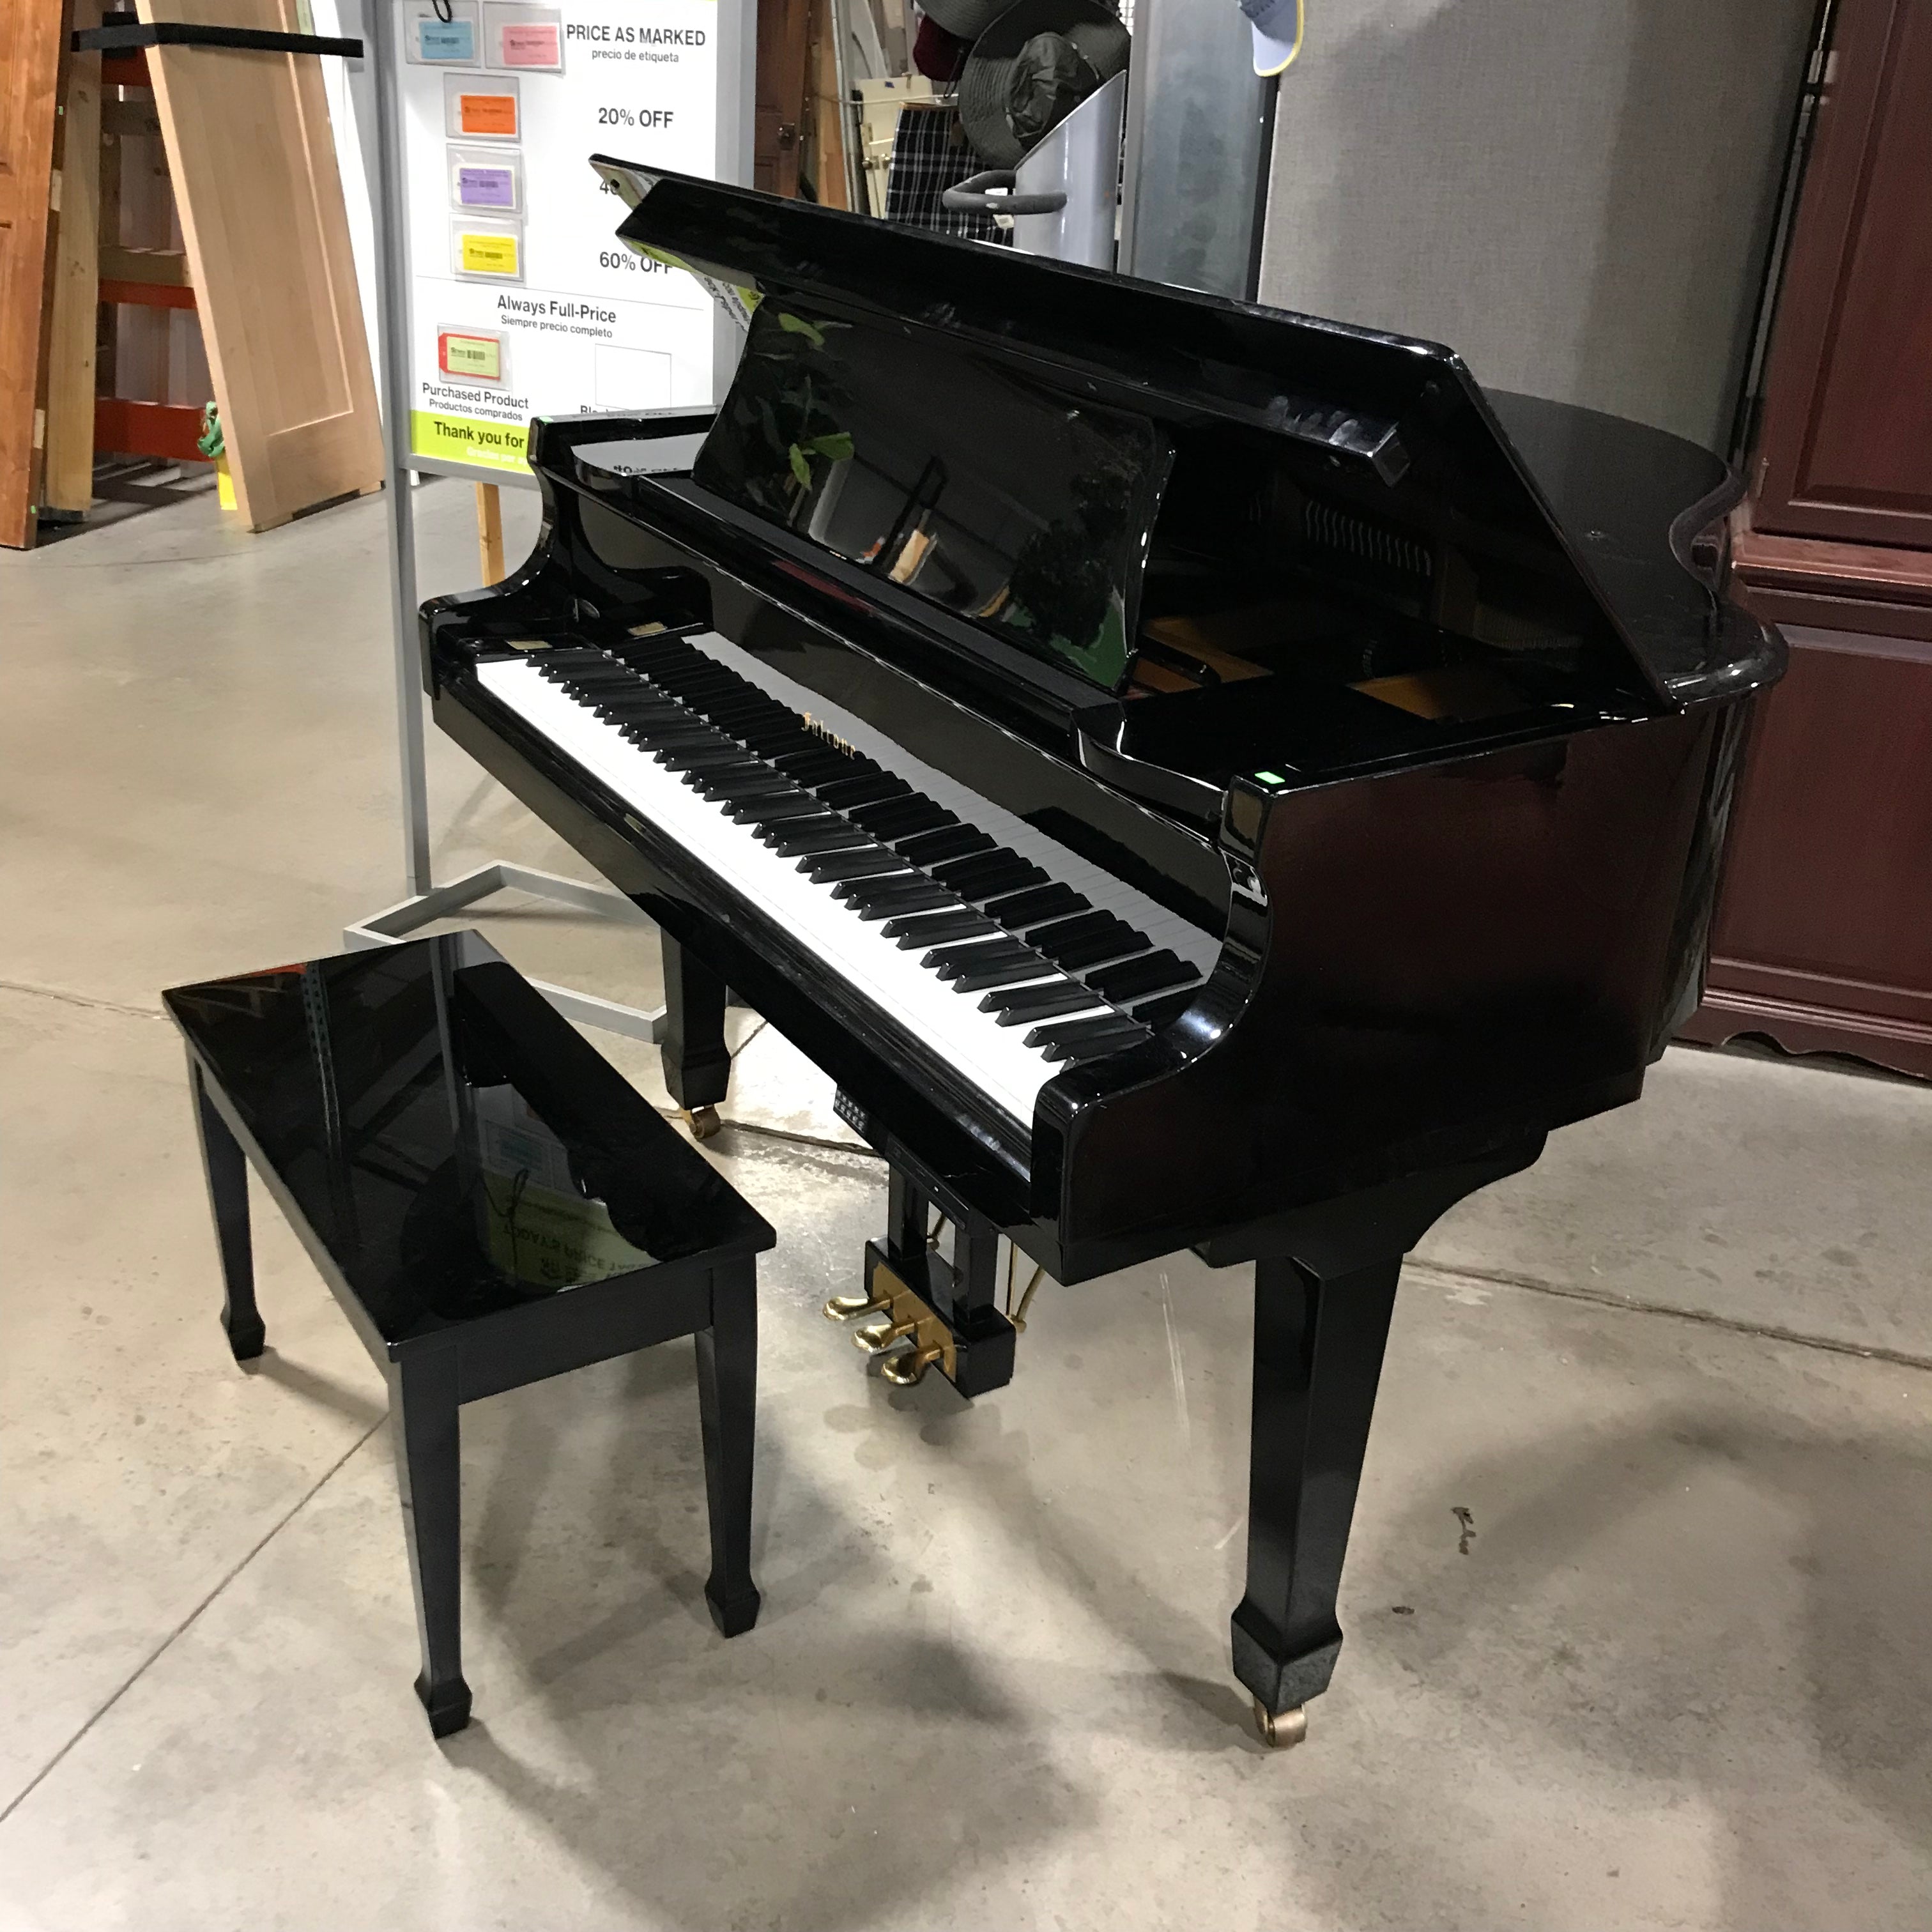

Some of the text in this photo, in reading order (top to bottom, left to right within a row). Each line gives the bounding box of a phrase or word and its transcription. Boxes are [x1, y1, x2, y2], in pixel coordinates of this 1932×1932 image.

[567, 24, 705, 45] PRICE AS MARKED
[592, 48, 679, 64] precio de etiqueta
[599, 108, 673, 128] 20% OFF
[599, 251, 636, 271] 60%
[498, 295, 617, 323] Always Full-Price
[502, 316, 613, 339] Siempre precio completo
[423, 383, 528, 411] Purchased Product
[430, 398, 524, 422] Productos comprados
[434, 422, 524, 448] Thank you for
